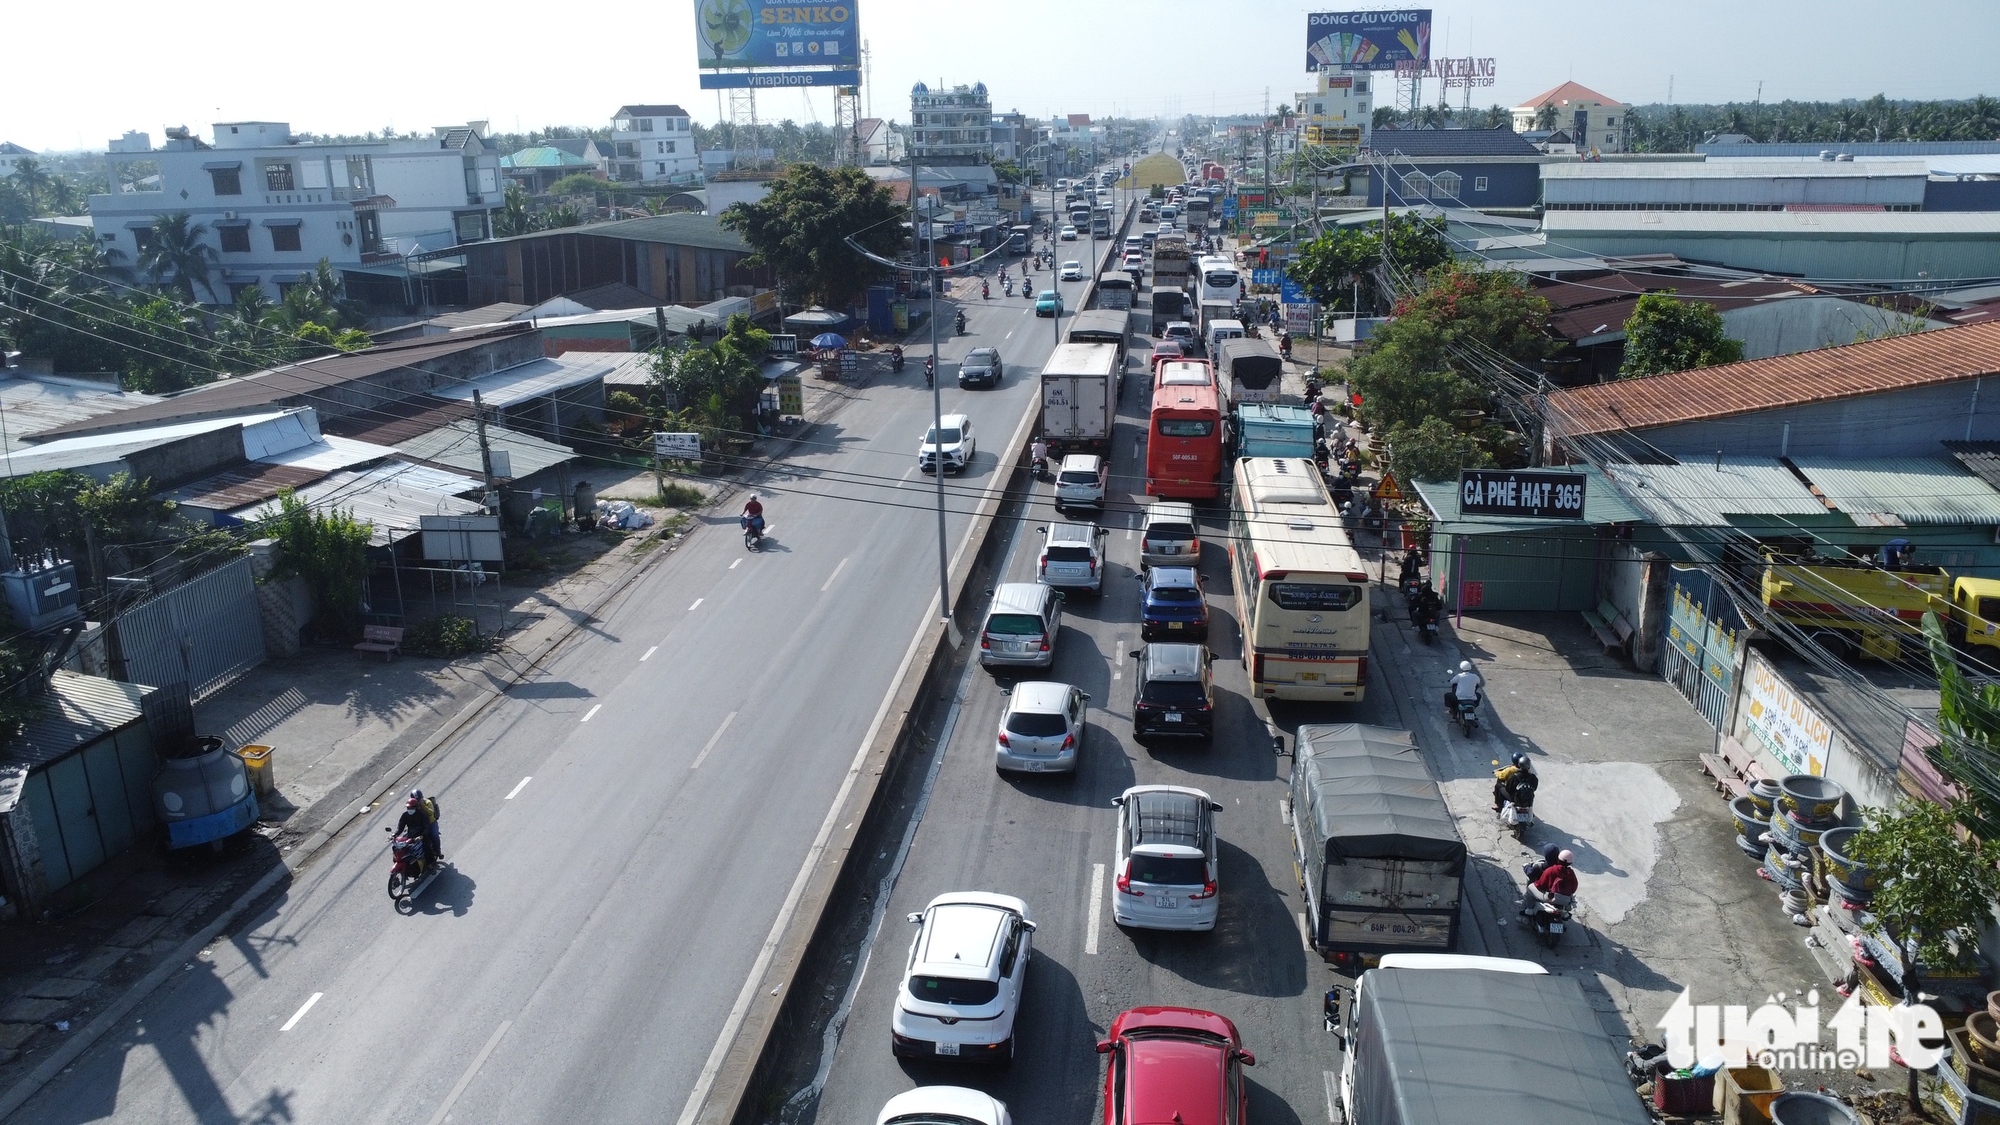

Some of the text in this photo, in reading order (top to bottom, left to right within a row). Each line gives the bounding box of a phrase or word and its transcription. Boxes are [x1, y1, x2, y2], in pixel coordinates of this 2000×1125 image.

[761, 6, 849, 24] SENKO
[747, 73, 813, 87] vinaphone
[1470, 78, 1495, 87] STOP
[1464, 474, 1581, 514] CÀ PHÊ HẠT 365
[1755, 665, 1829, 750] DỊCH VỤ DU LỊCH
